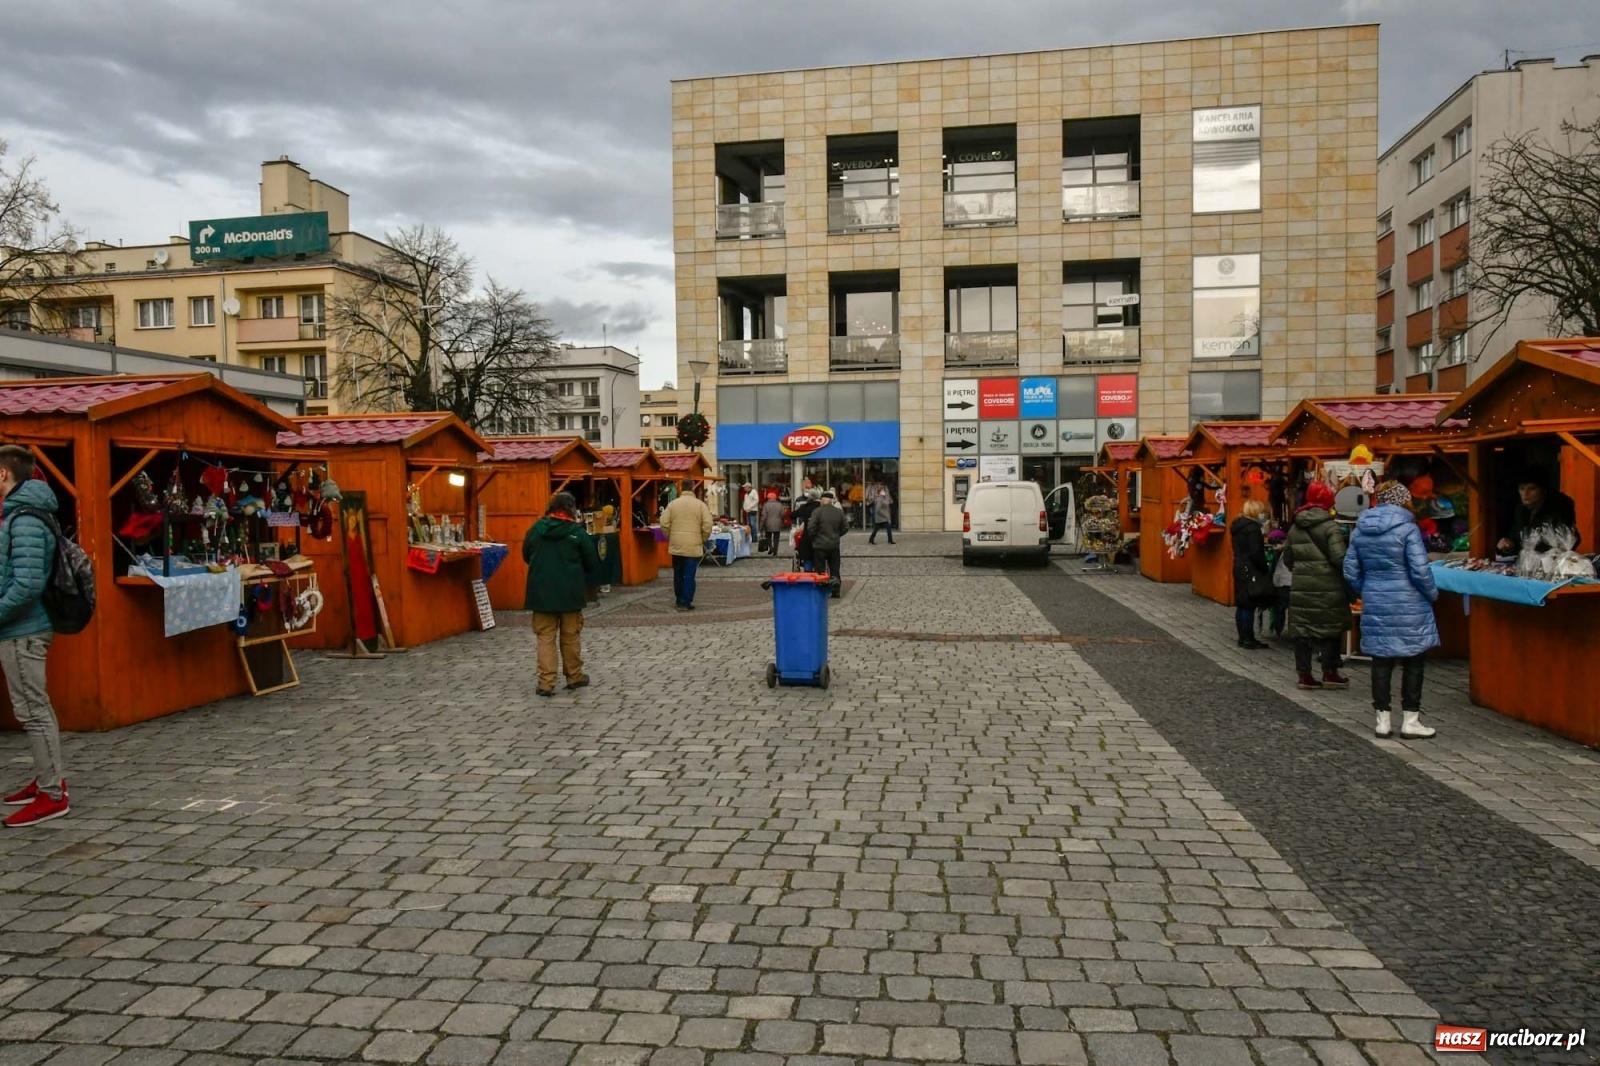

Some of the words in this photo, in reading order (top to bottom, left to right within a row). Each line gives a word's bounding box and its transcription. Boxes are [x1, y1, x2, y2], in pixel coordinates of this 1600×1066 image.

[1198, 123, 1255, 134] ADWOKACKA
[223, 229, 293, 244] McDonald's
[195, 246, 211, 254] 300
[952, 389, 976, 397] PIĘTRO
[950, 427, 977, 435] PIĘTRO
[787, 435, 826, 446] PEPCO
